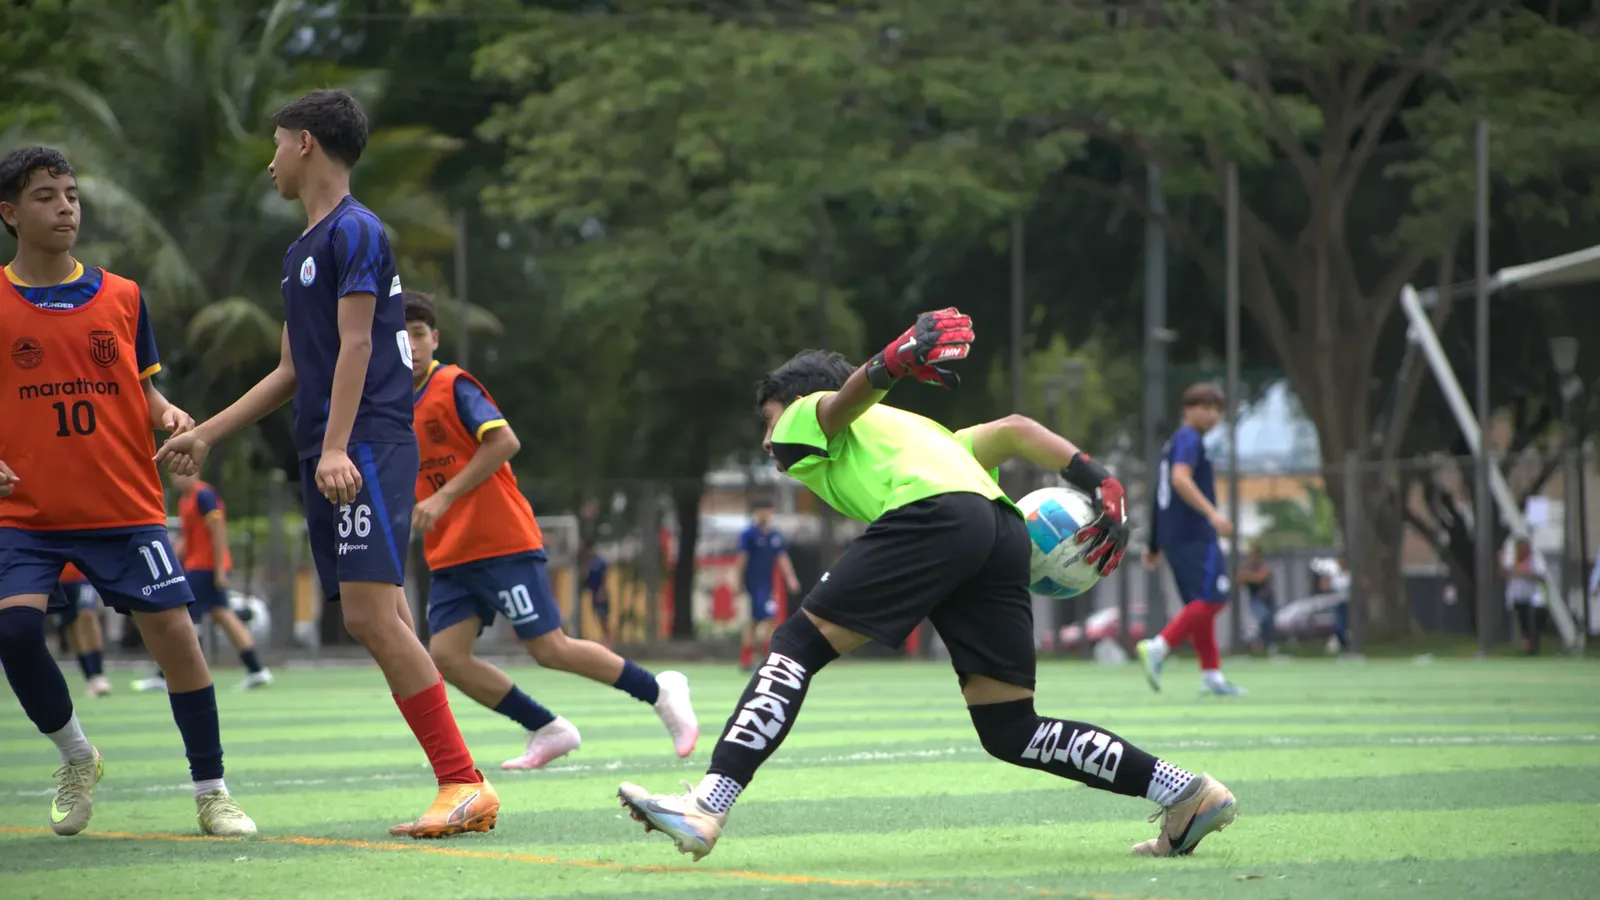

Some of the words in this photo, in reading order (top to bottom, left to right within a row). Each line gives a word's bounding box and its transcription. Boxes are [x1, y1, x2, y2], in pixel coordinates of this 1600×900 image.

[19, 377, 119, 399] marathon
[52, 400, 96, 437] 10
[338, 504, 372, 538] 36
[138, 540, 174, 580] 11
[498, 584, 534, 619] 30
